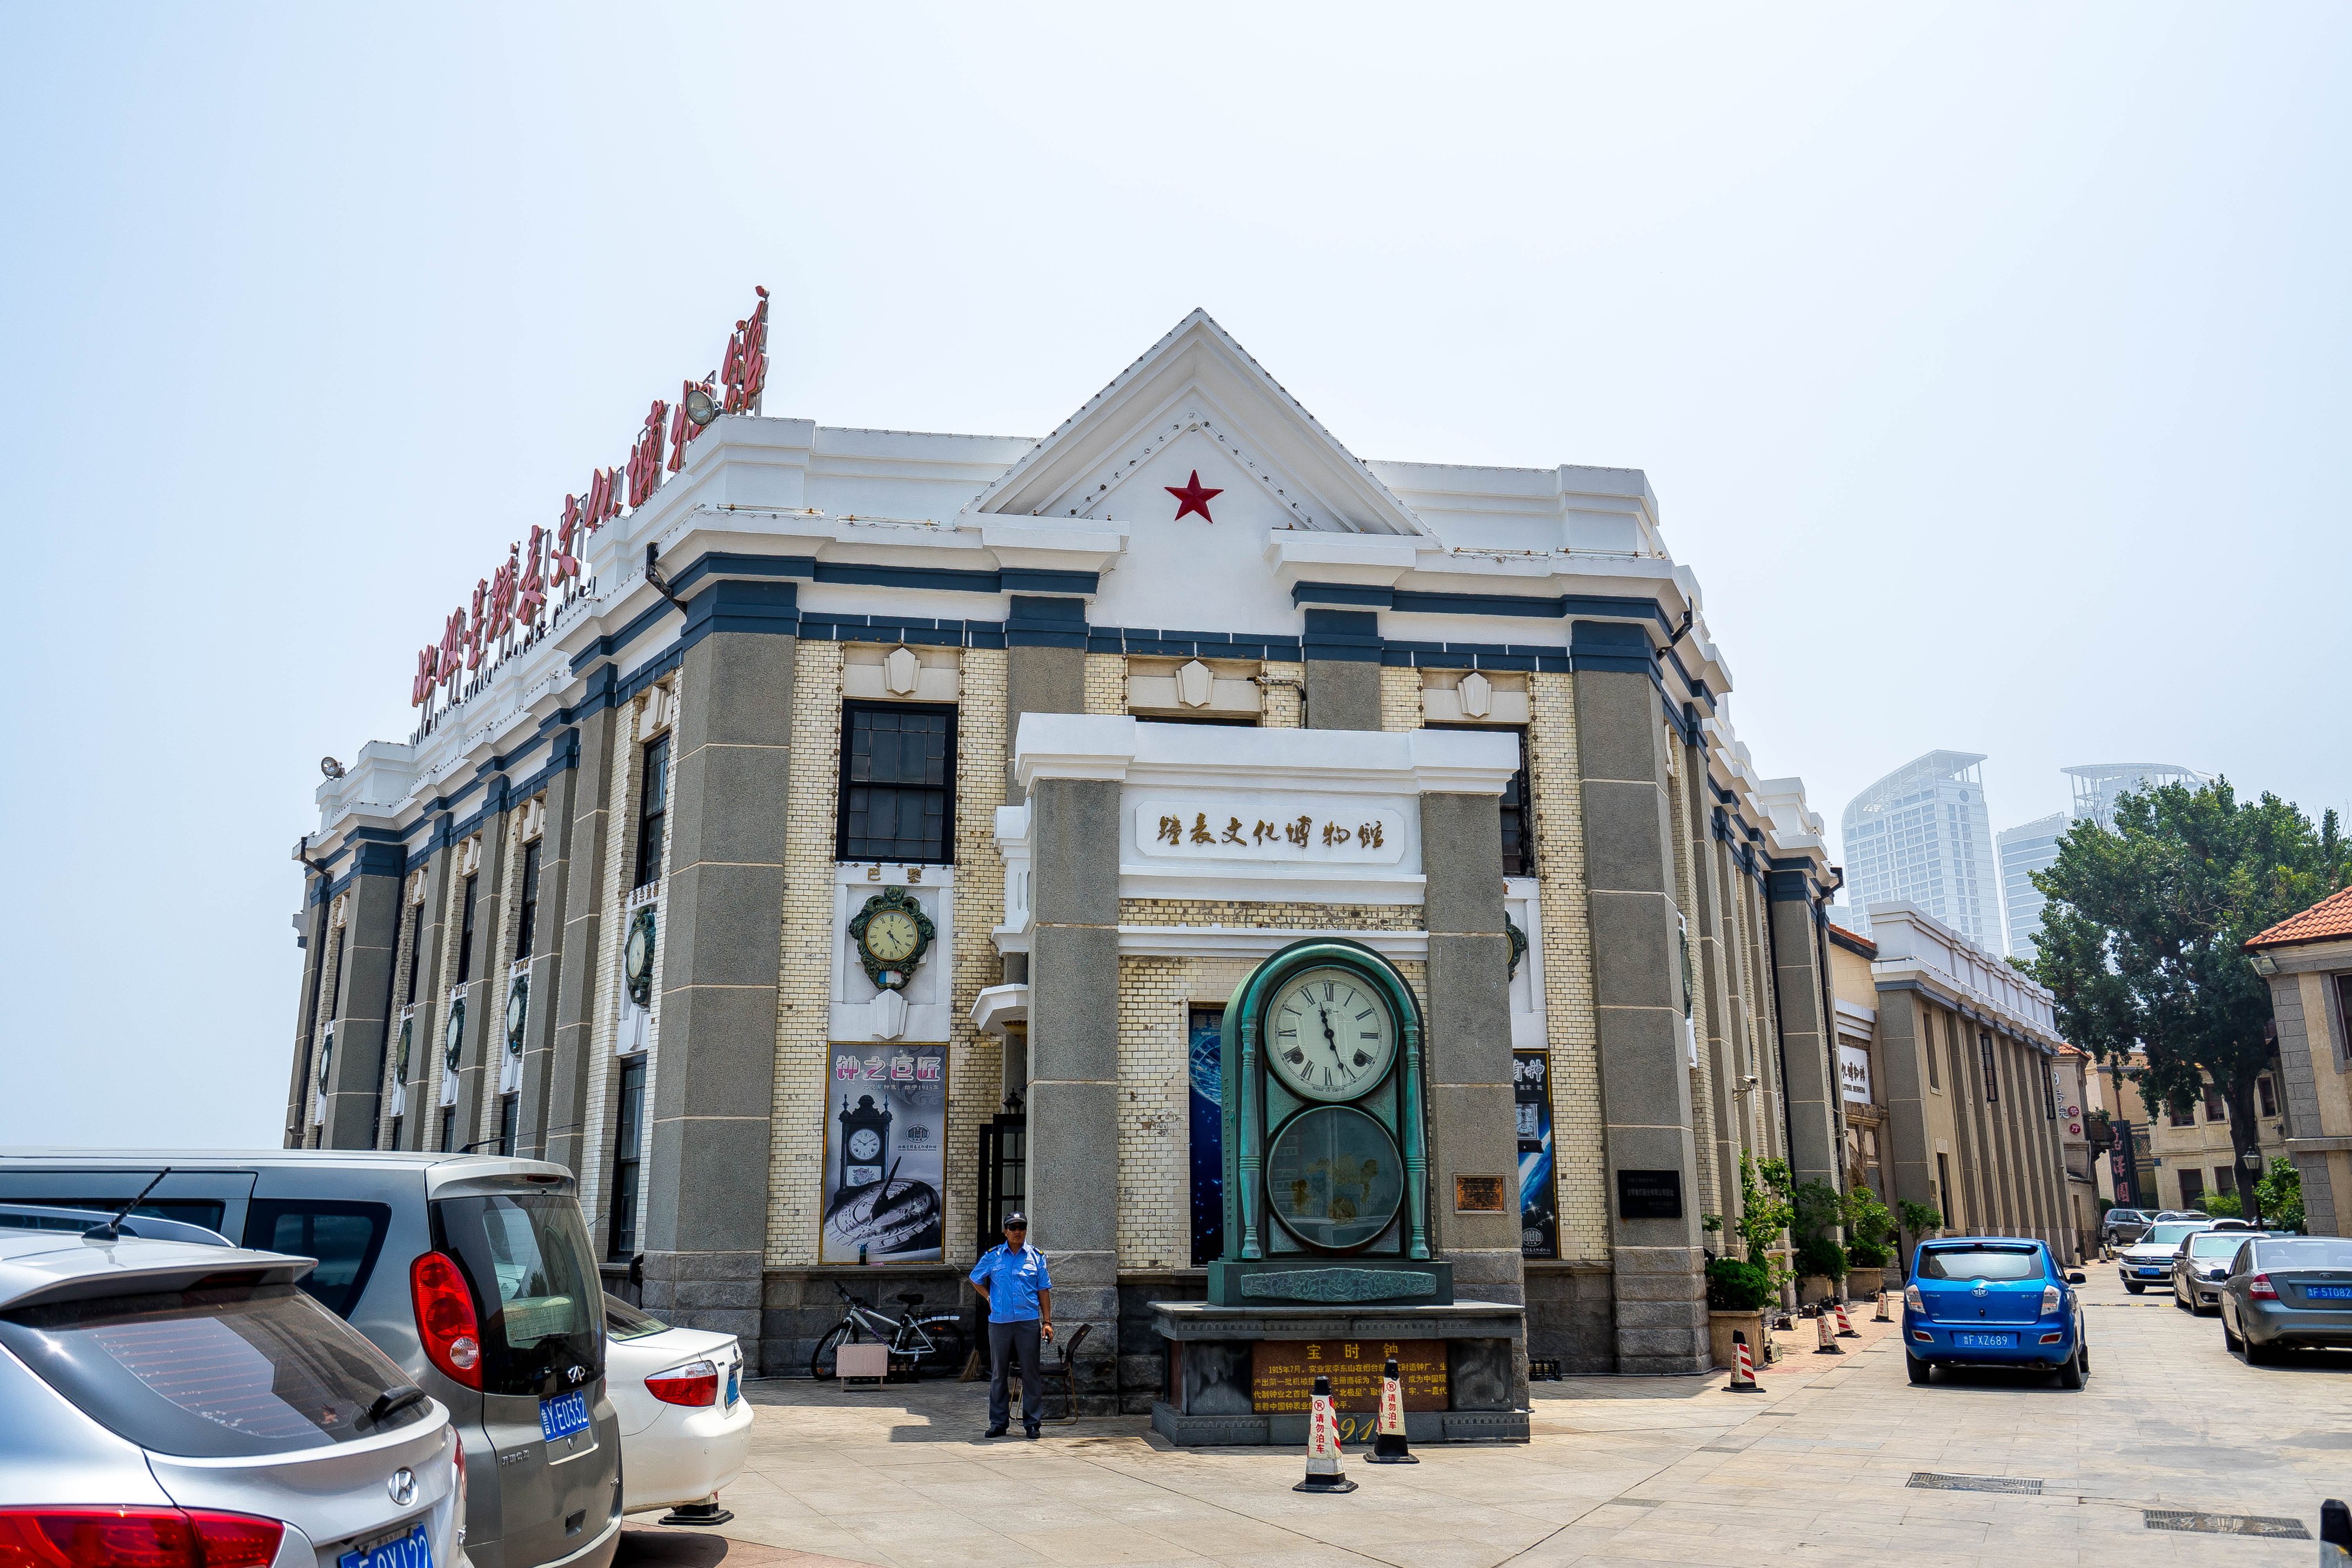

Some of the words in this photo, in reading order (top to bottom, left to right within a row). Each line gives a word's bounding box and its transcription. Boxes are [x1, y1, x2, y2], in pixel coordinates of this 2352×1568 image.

[836, 1055, 941, 1081] 钟之巨匠
[1387, 1393, 1397, 1430] 请勿泊车
[1315, 1413, 1325, 1454] 请勿泊车
